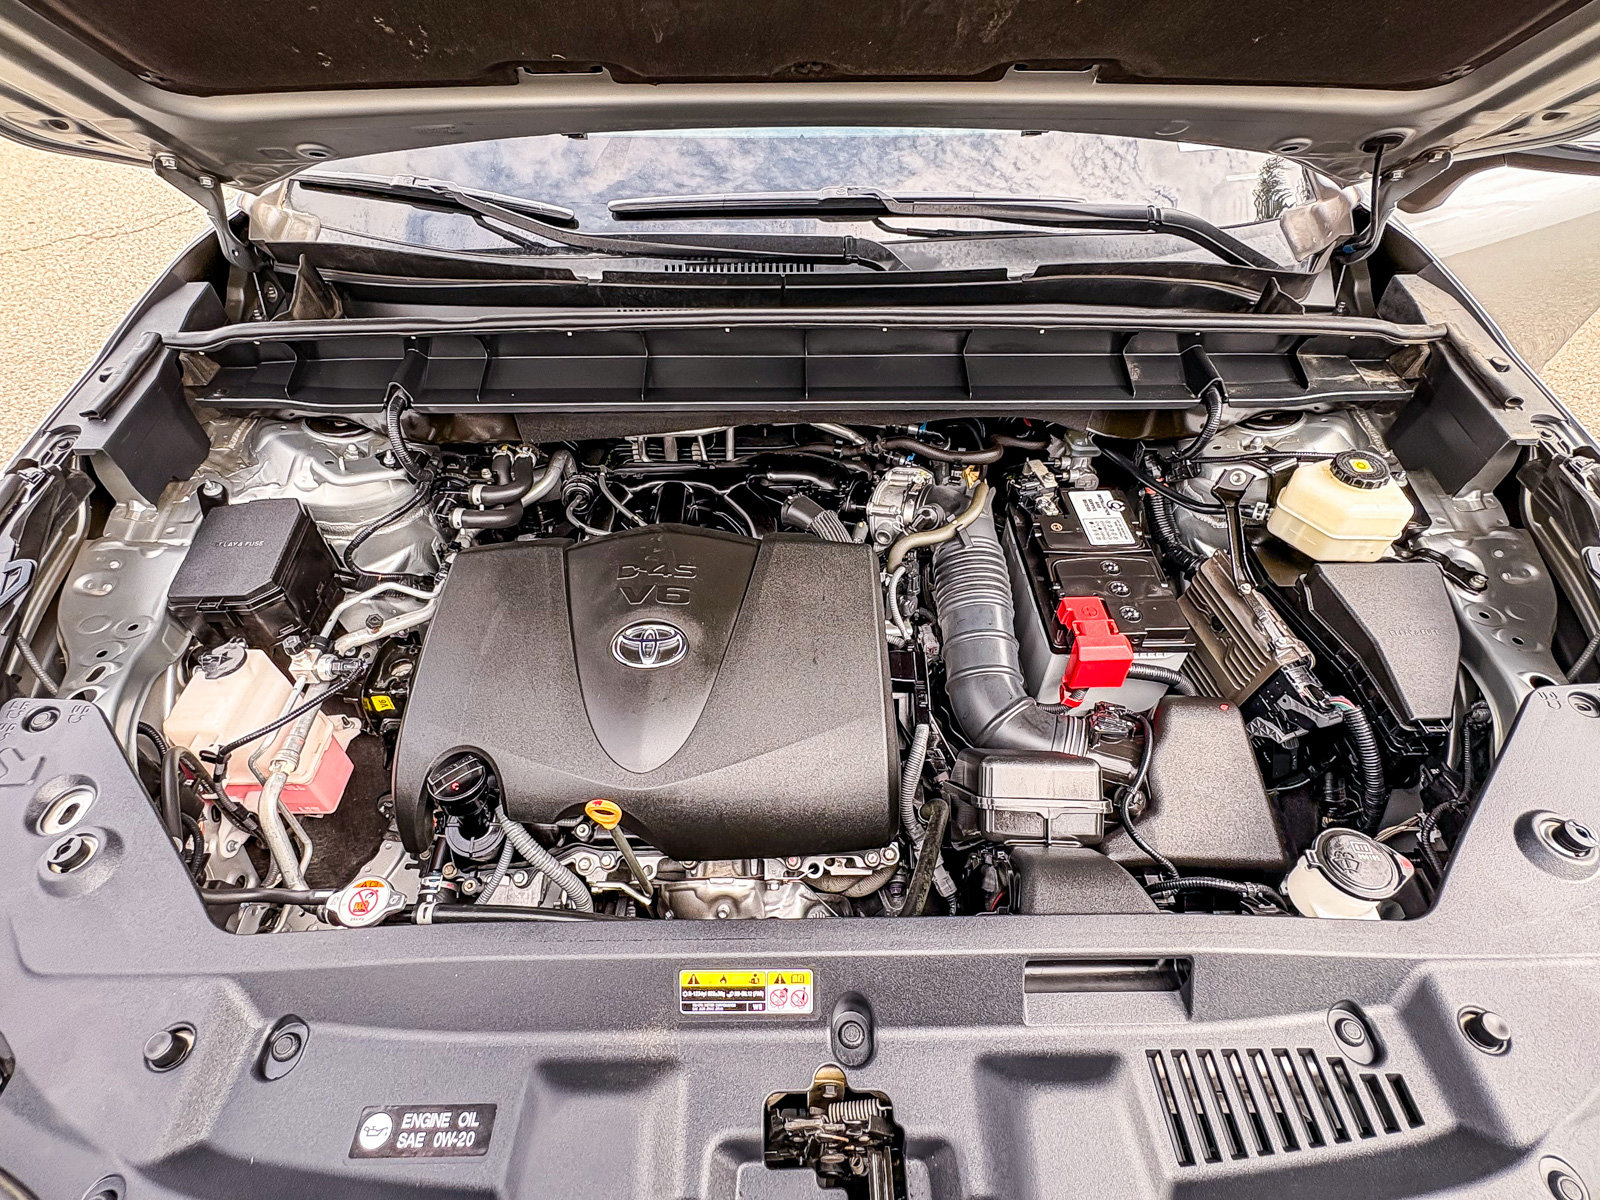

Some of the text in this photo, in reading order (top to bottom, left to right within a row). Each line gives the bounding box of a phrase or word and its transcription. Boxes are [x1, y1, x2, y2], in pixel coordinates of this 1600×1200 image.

[617, 564, 697, 580] D-4S
[620, 585, 690, 605] V6
[401, 1111, 480, 1128] ENGINE OIL
[396, 1131, 475, 1148] SAE 0W-20
